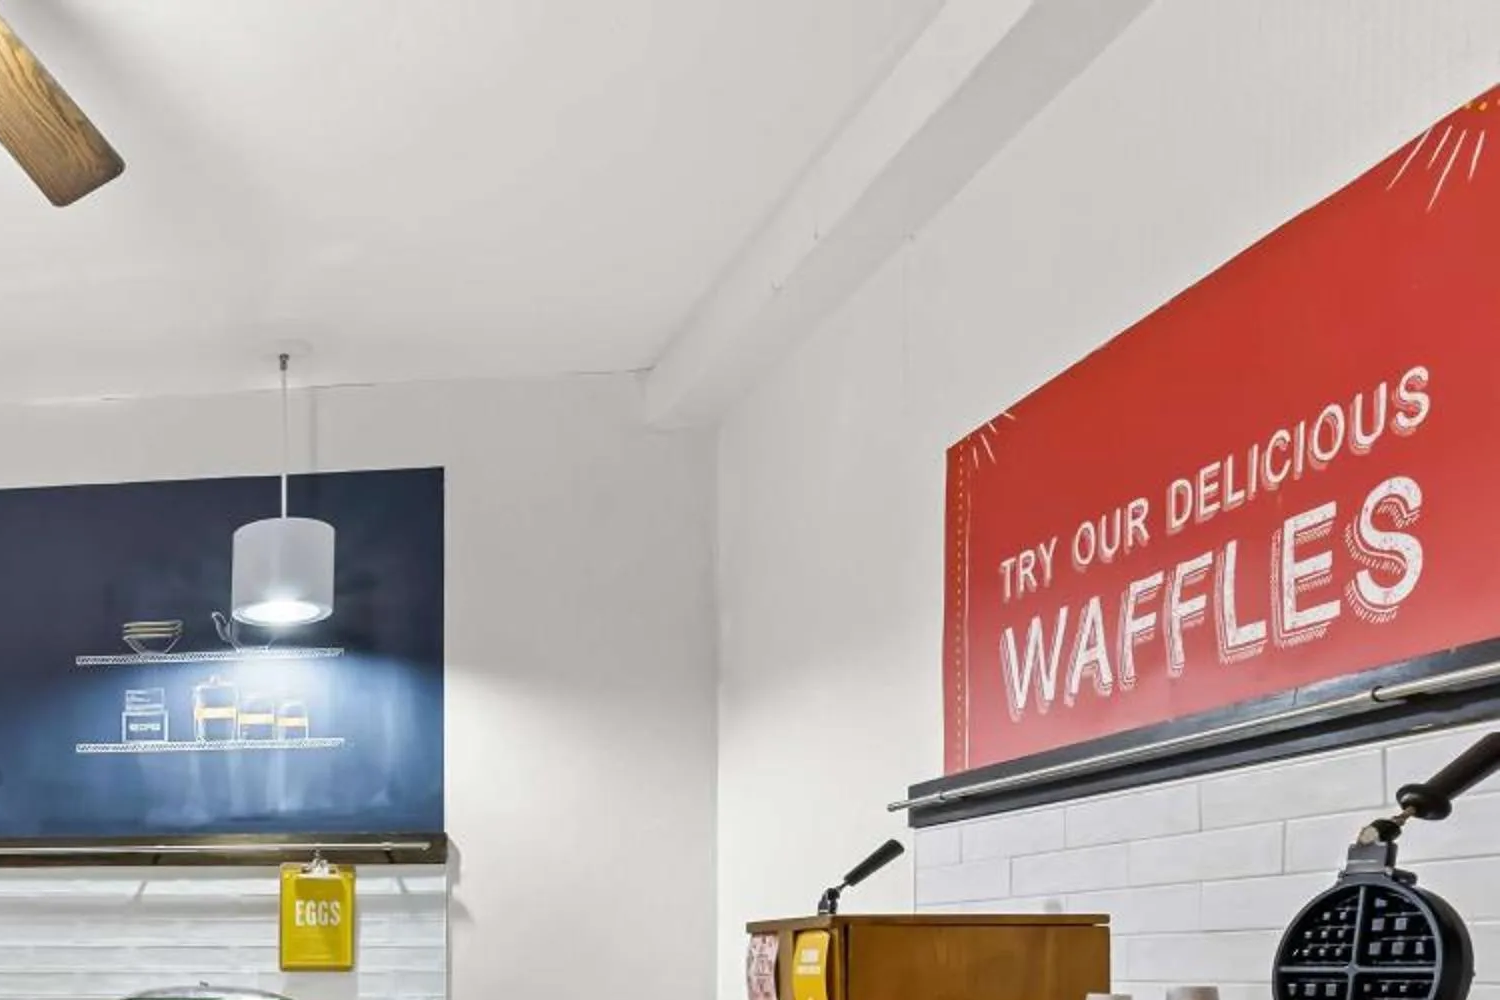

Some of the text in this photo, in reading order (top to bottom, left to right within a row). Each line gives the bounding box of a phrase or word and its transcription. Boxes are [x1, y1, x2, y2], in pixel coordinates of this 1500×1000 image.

[1001, 365, 1431, 600] TRY OUR DELICIOUS
[1001, 475, 1424, 723] WAFFLES
[295, 900, 341, 926] EGGS
